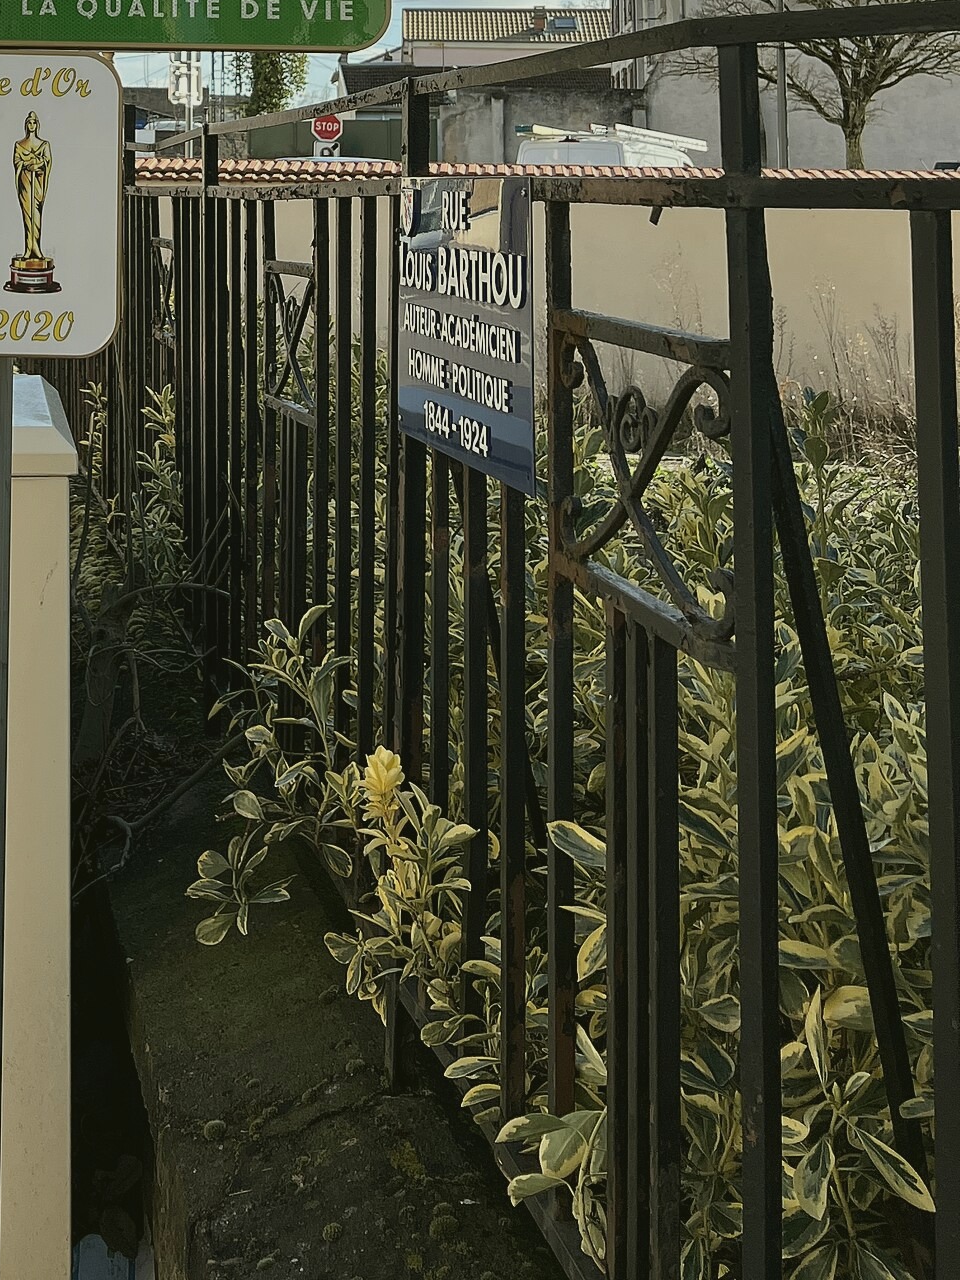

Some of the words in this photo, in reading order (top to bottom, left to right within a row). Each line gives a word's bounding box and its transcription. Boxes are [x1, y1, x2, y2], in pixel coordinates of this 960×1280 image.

[241, 0, 281, 20] DE
[300, 0, 354, 21] VIE
[20, 67, 92, 98] d'Or
[315, 121, 340, 132] STOP
[441, 190, 467, 230] RUE
[399, 240, 433, 292] LOUIS
[438, 246, 522, 309] BARTHOU
